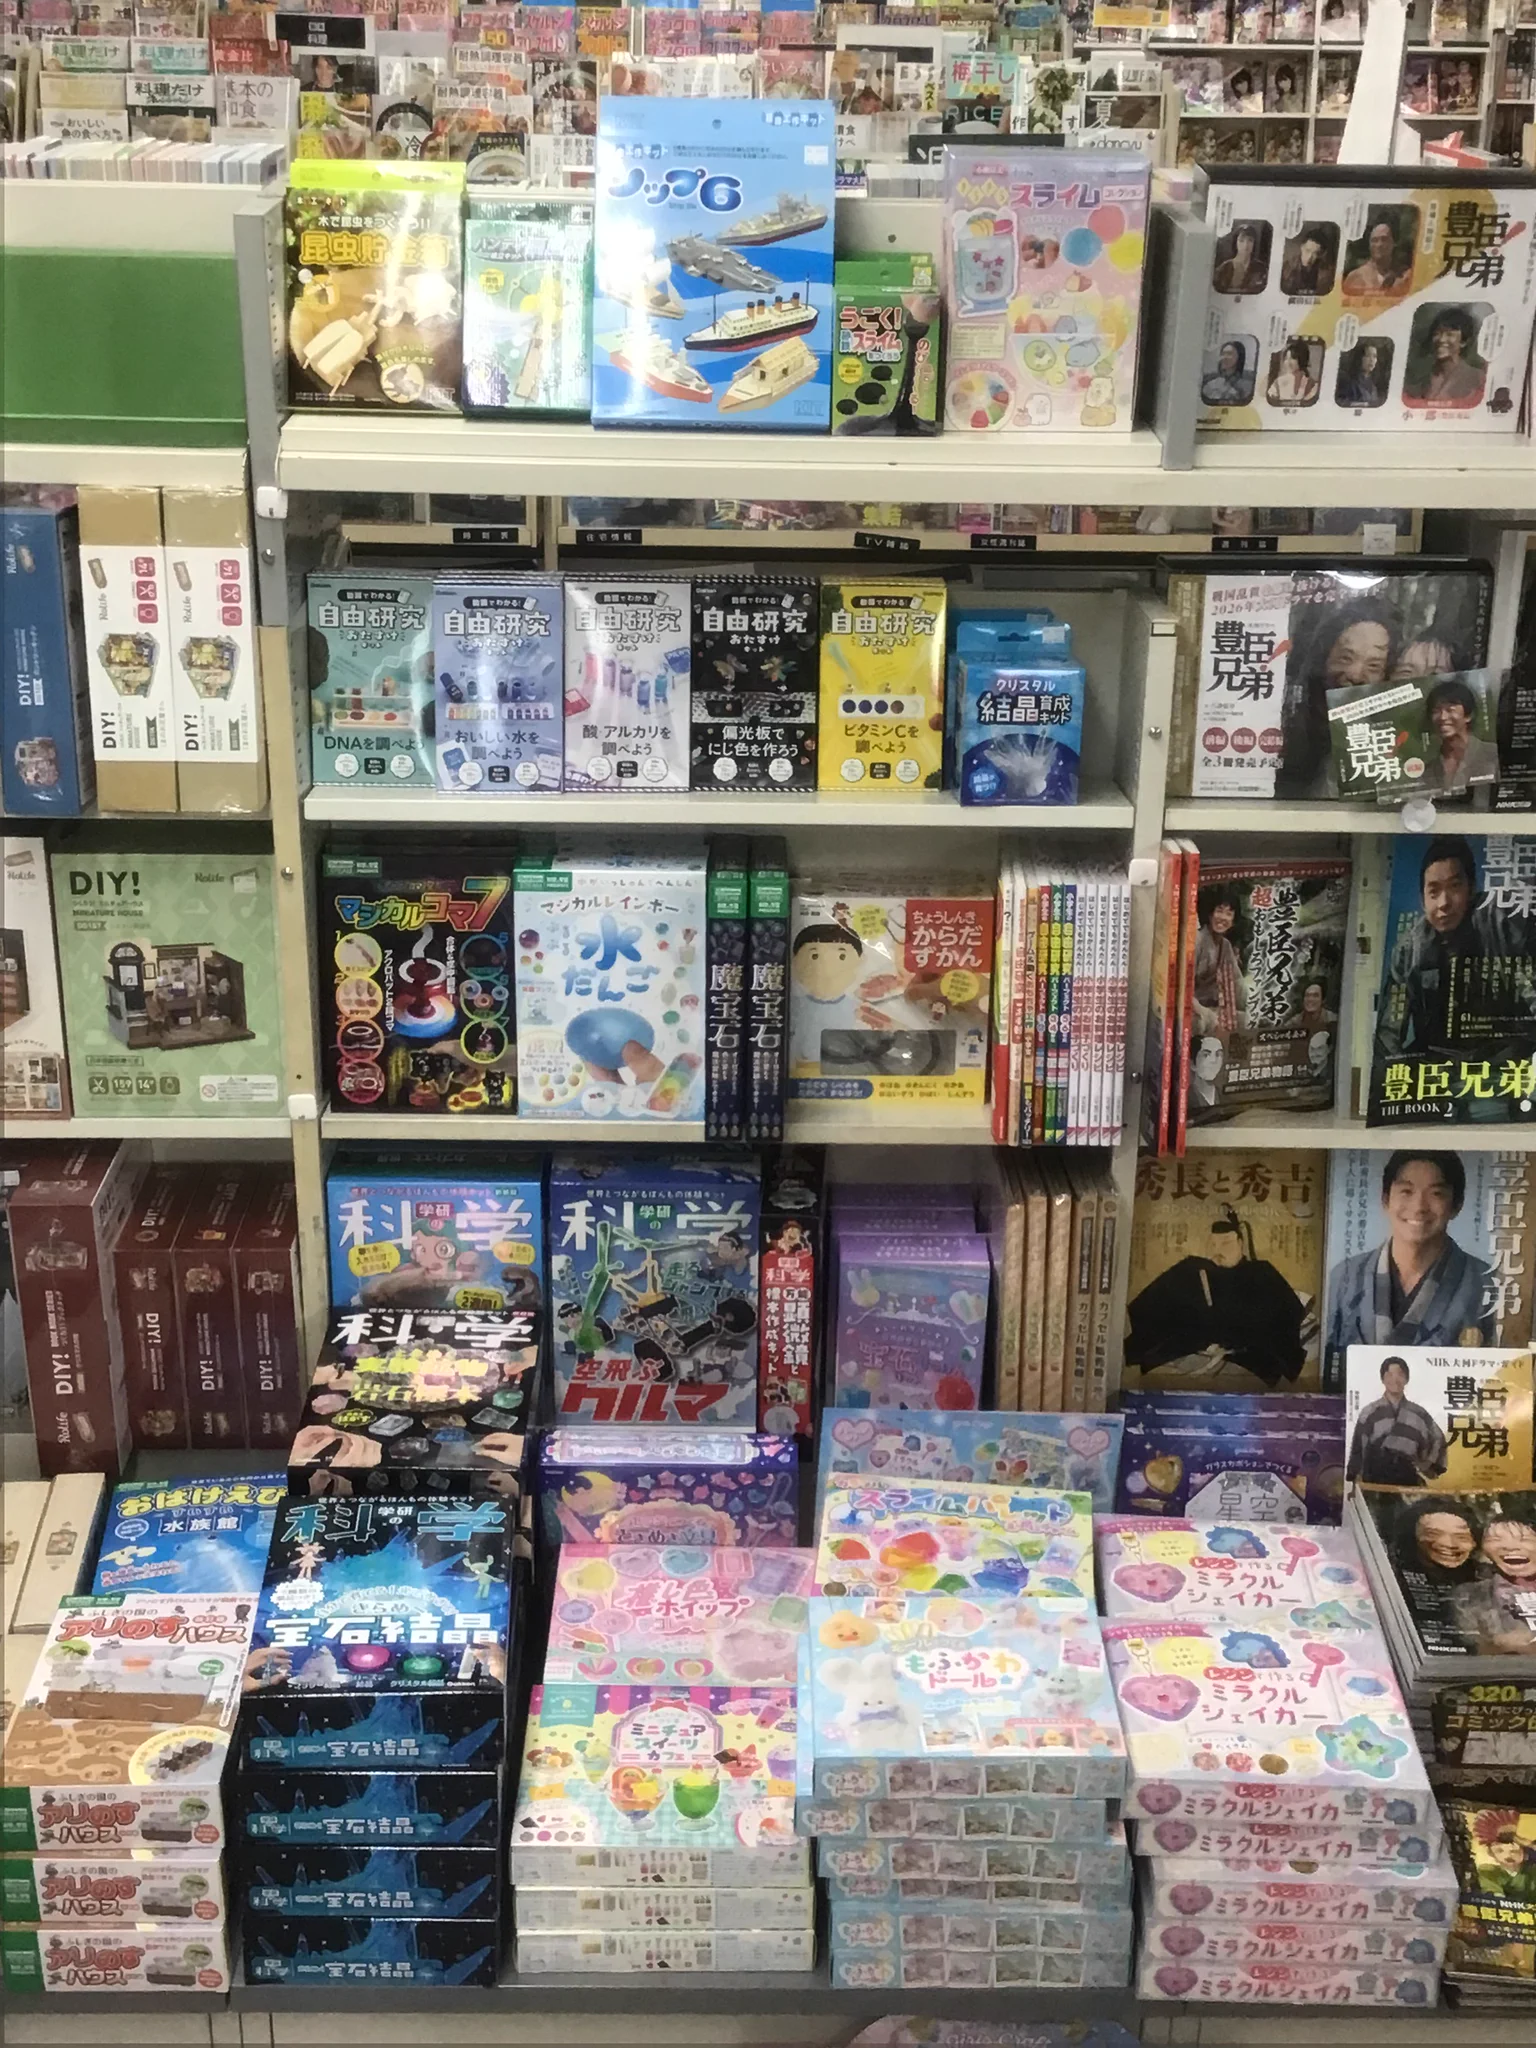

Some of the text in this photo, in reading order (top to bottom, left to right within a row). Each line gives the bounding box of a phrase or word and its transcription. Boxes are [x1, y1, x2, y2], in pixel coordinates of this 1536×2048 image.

[952, 61, 1015, 84] 梅干し
[67, 119, 105, 128] おいしい
[1088, 97, 1119, 129] 夏
[1010, 183, 1101, 210] スライム
[318, 216, 431, 230] 木で昆虫をつくう!!
[300, 232, 448, 267] 昆虫貯金箱
[840, 306, 903, 330] うごく!
[853, 330, 903, 352] スライム
[318, 601, 425, 630] 自由研究
[443, 610, 551, 637] 自由研究
[574, 607, 682, 632] 自由研究
[702, 606, 808, 634] 自由研究
[831, 609, 937, 637] 自由研究
[729, 634, 781, 646] おたすけ
[20, 673, 32, 706] DIY!
[996, 679, 1056, 692] クリスタル
[979, 692, 1039, 723] 結晶
[1040, 695, 1072, 711] 育成
[1040, 711, 1071, 723] キット
[102, 711, 117, 749] DIY!
[186, 714, 200, 751] DIY!
[455, 729, 540, 744] おいしい水を
[722, 725, 785, 740] 偏光板で
[843, 723, 919, 739] ビタミンCを
[471, 746, 523, 761] 調べよう
[601, 742, 653, 756] 調べよう
[708, 742, 799, 757] にじ色を作ろう
[855, 741, 907, 755] 調べよう
[69, 871, 140, 896] DIY!
[72, 909, 144, 918] MINIATURE HOUSE
[335, 876, 510, 932] マジカルコマ7
[540, 895, 680, 914] マジカルレインボー
[911, 910, 976, 924] ちょうしんき
[575, 914, 643, 971] 水
[911, 925, 983, 946] からだ
[911, 947, 983, 968] ずかん
[562, 965, 661, 1001] だんご
[708, 963, 744, 1048] 魔宝石
[749, 963, 785, 1048] 魔宝石
[1381, 1102, 1454, 1118] THE BOOK 2
[1135, 1161, 1316, 1203] 秀長と秀吉
[418, 1204, 451, 1217] 学研
[639, 1205, 672, 1219] 学研
[146, 1313, 162, 1344] DIY!
[766, 1287, 782, 1374] 標本作成キット
[52, 1353, 73, 1395] DIY!
[200, 1360, 215, 1391] DIY!
[260, 1359, 274, 1391] DIY!
[571, 1358, 666, 1382] 空飛ぶ
[560, 1383, 730, 1422] クルマ
[58, 1412, 71, 1443] Rolife
[378, 1505, 414, 1516] 学研
[1215, 1493, 1280, 1522] 星空
[162, 1517, 240, 1532] 水族館
[1197, 1571, 1285, 1590] ミラクル
[656, 1597, 751, 1618] ホイップ
[1187, 1588, 1303, 1608] シェイカー
[55, 1616, 189, 1642] アリのす
[169, 1626, 248, 1644] ハウス
[266, 1612, 500, 1648] 宝石結晶
[929, 1673, 998, 1690] ドール
[1213, 1685, 1309, 1705] ミラクル
[1202, 1705, 1329, 1725] シェイカー
[630, 1723, 707, 1737] ミニチュア
[327, 1738, 420, 1758] 宝石結晶
[634, 1737, 699, 1751] スイーツ
[647, 1750, 685, 1762] カフェ
[37, 1801, 141, 1829] アリのす
[59, 1826, 122, 1844] ハウス
[322, 1817, 414, 1835] 宝石結晶
[40, 1875, 141, 1901] アリのす
[61, 1899, 123, 1917] ハウス
[323, 1891, 415, 1909] 宝石結晶
[45, 1946, 145, 1971] アリのす
[66, 1968, 127, 1986] ハウス
[325, 1962, 415, 1979] 宝石結晶
